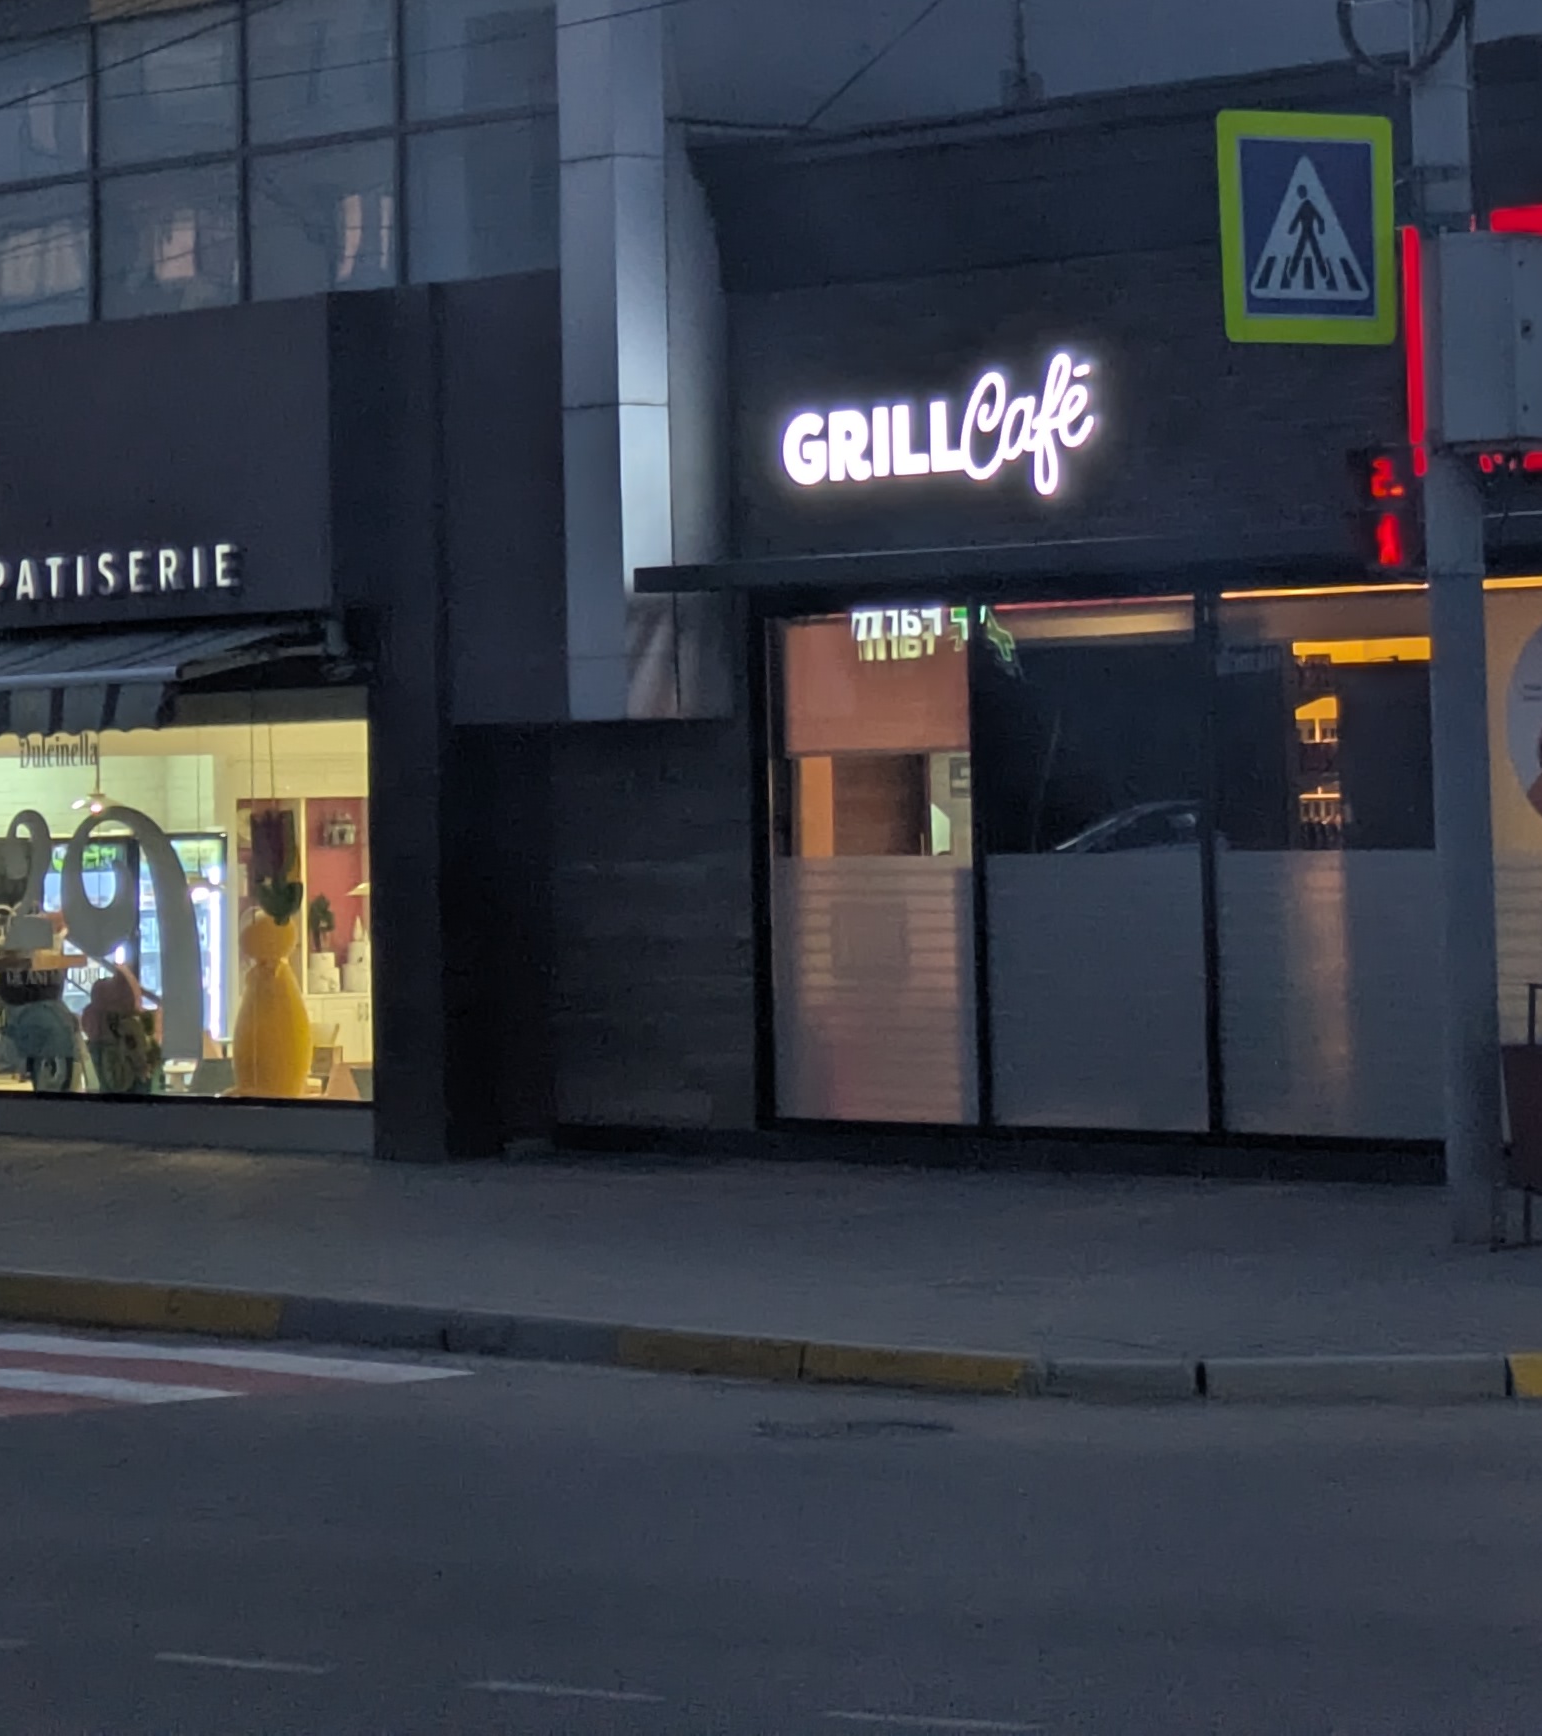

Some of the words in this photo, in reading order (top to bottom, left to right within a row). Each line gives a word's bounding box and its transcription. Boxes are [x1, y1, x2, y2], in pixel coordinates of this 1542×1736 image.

[782, 400, 963, 487] GRILL
[960, 351, 1096, 497] Café
[19, 732, 99, 769] Dulcinella
